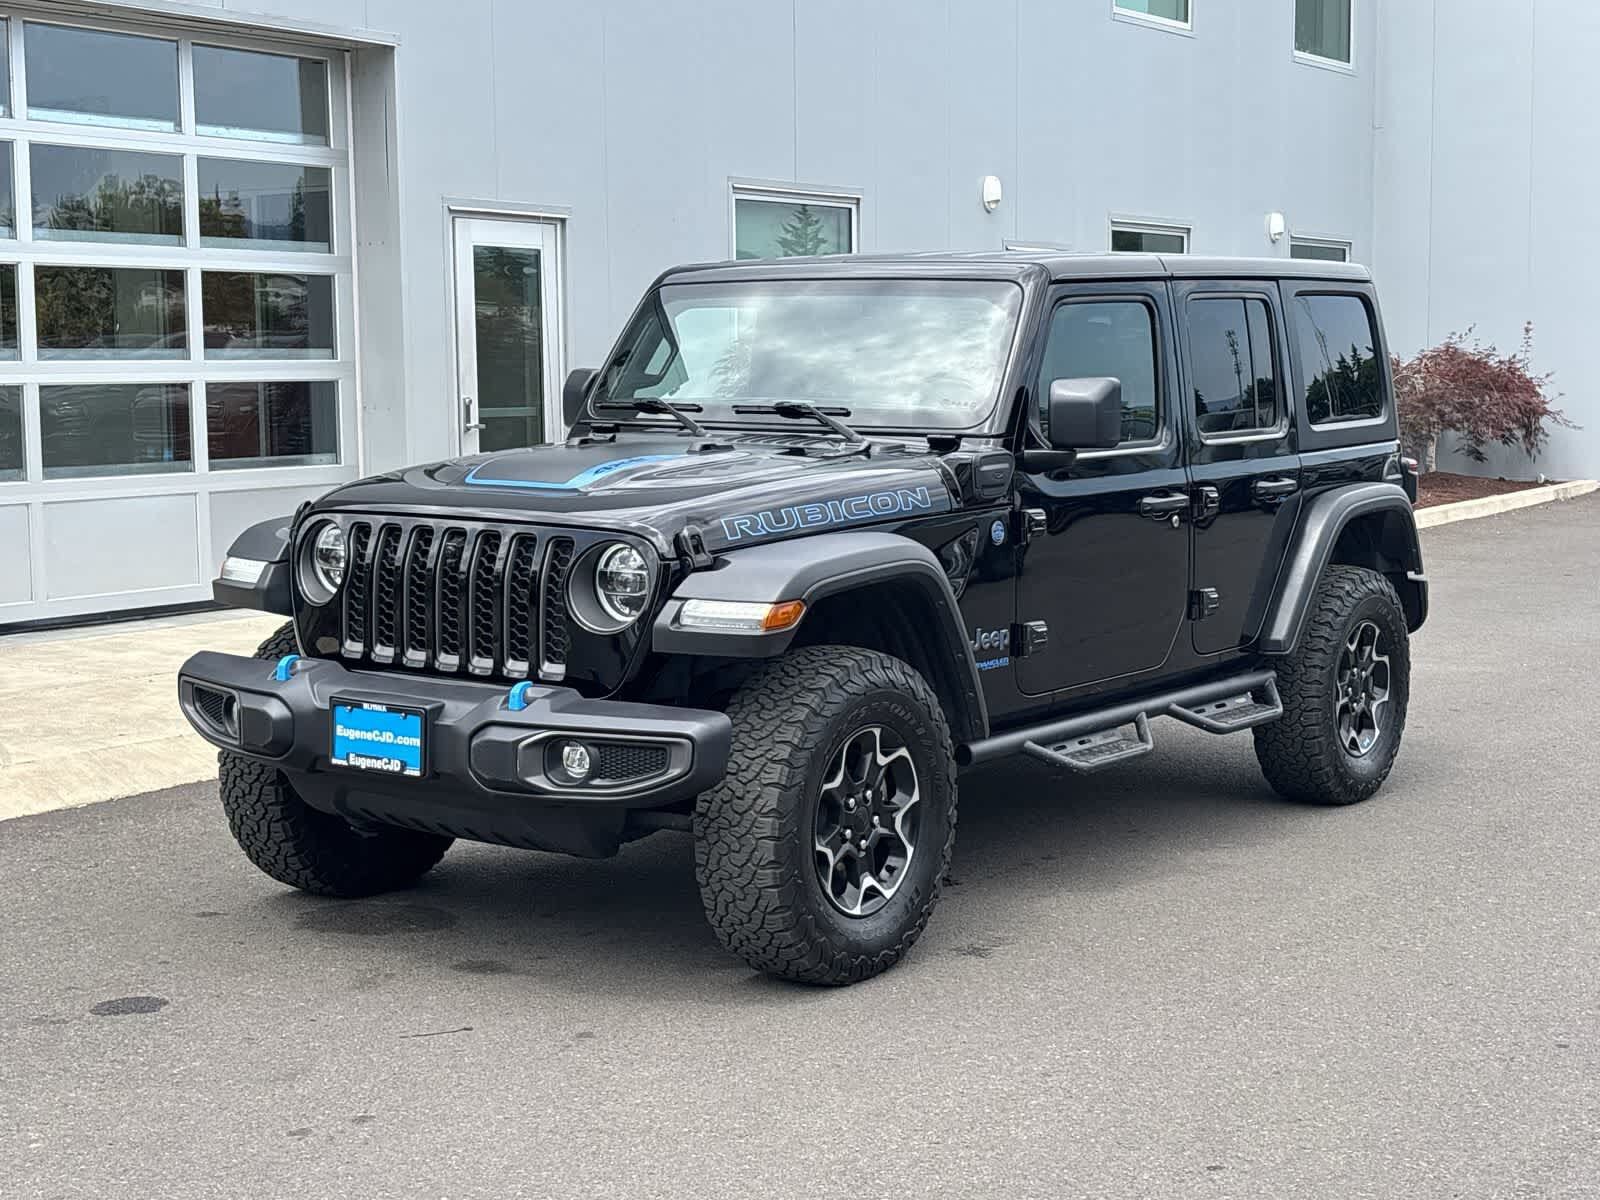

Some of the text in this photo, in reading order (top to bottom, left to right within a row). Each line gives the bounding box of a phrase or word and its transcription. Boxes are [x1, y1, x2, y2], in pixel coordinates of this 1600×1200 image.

[720, 486, 932, 541] RUBICON
[969, 627, 1009, 651] Jeep
[336, 724, 420, 747] EugeneCJD.com
[349, 752, 401, 772] EugeneCJD
